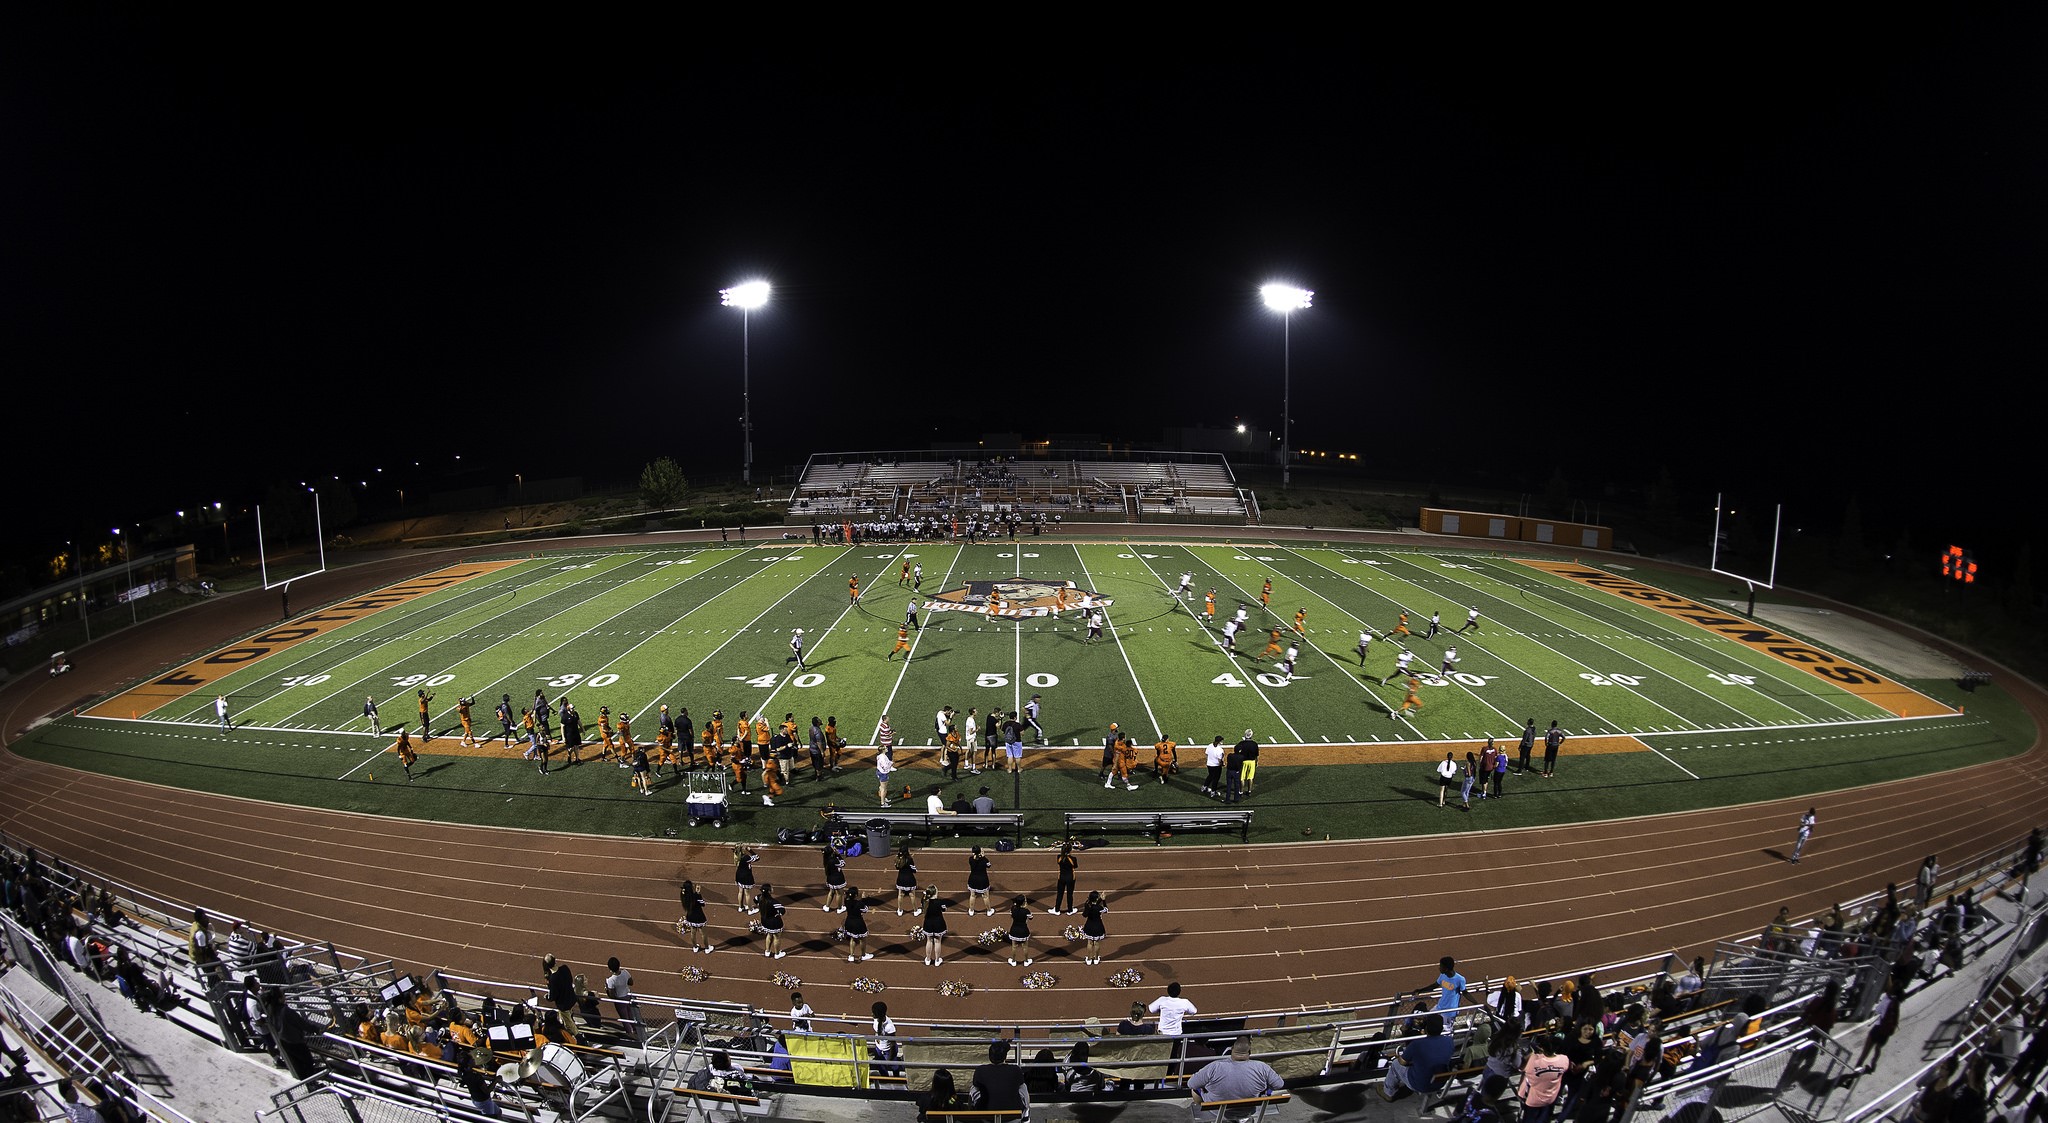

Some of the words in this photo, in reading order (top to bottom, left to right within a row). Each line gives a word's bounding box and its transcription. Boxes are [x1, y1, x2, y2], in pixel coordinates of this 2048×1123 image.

[151, 570, 484, 686] FOOTHILL
[1553, 569, 1882, 685] MUSTANGS
[281, 674, 332, 686] 10
[393, 673, 457, 687] 20
[547, 673, 621, 688] 30
[745, 673, 827, 688] 40
[975, 672, 1060, 688] 50
[1210, 672, 1292, 688] 40
[1413, 673, 1487, 688] 30
[1579, 672, 1641, 687] 20
[1706, 673, 1757, 686] 10
